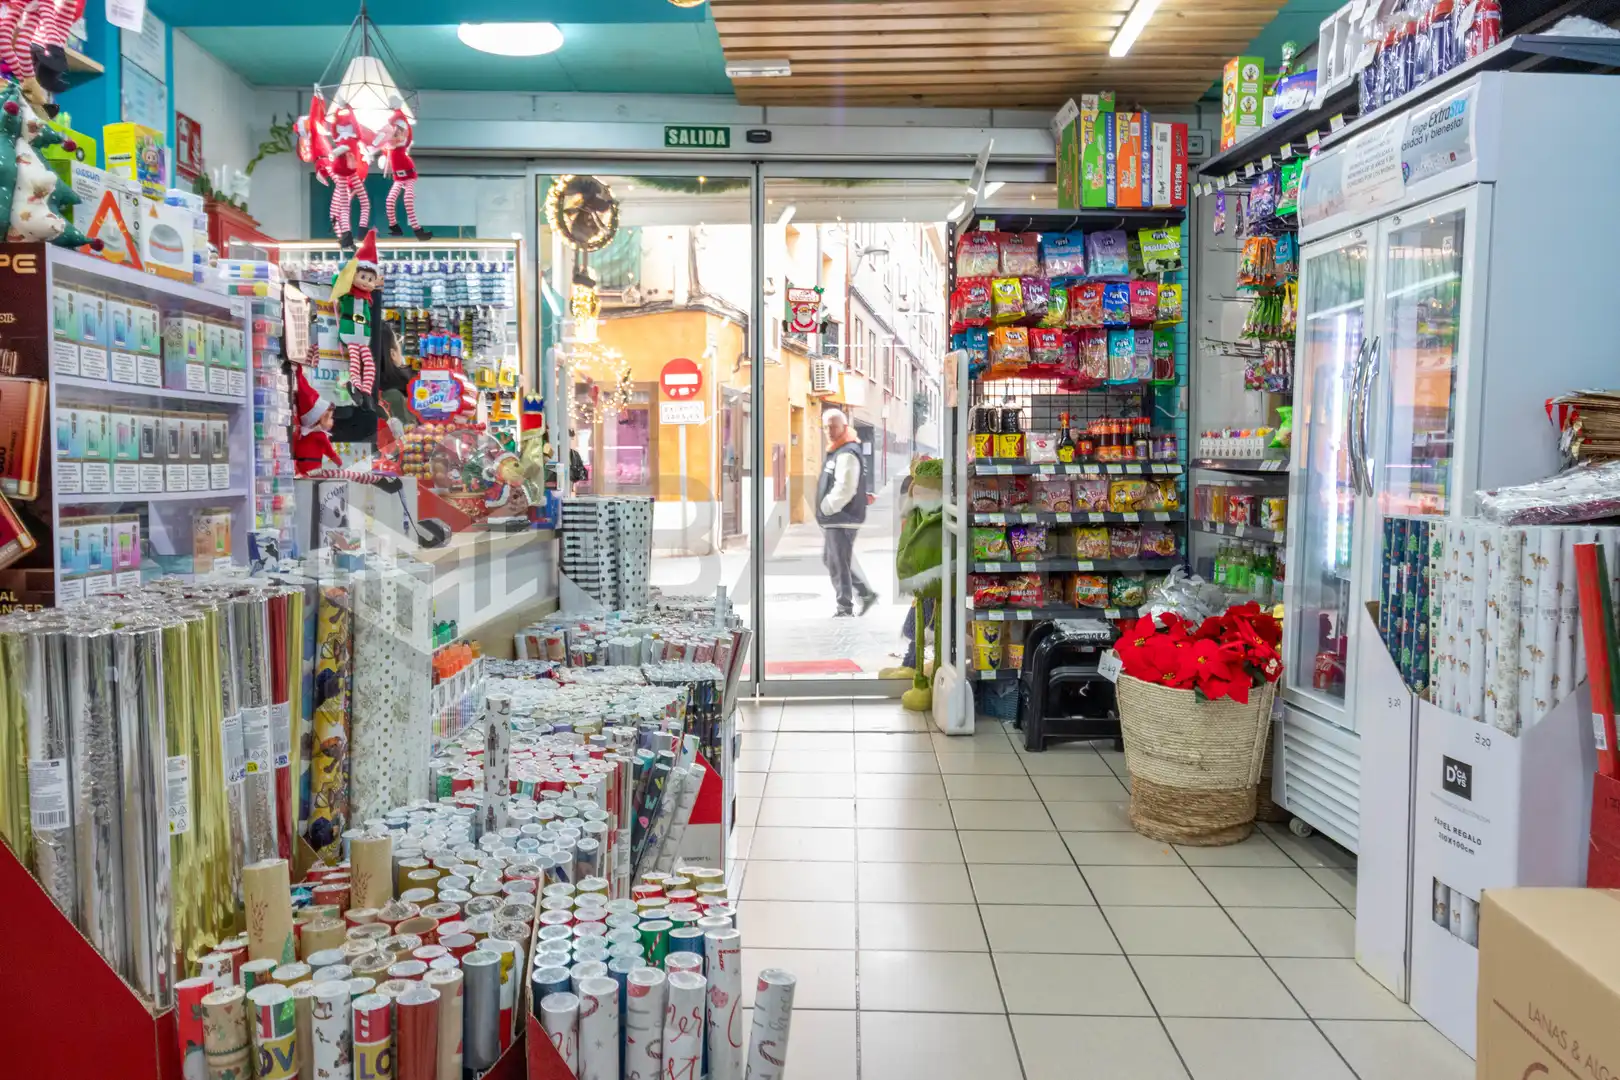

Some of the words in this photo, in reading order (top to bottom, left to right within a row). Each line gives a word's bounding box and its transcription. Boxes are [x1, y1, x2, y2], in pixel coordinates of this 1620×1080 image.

[668, 128, 726, 146] SALIDA
[1401, 134, 1423, 151] alidad
[1452, 827, 1482, 846] REGALO
[1528, 1001, 1568, 1051] LANAS
[1585, 1054, 1620, 1080] ALG
